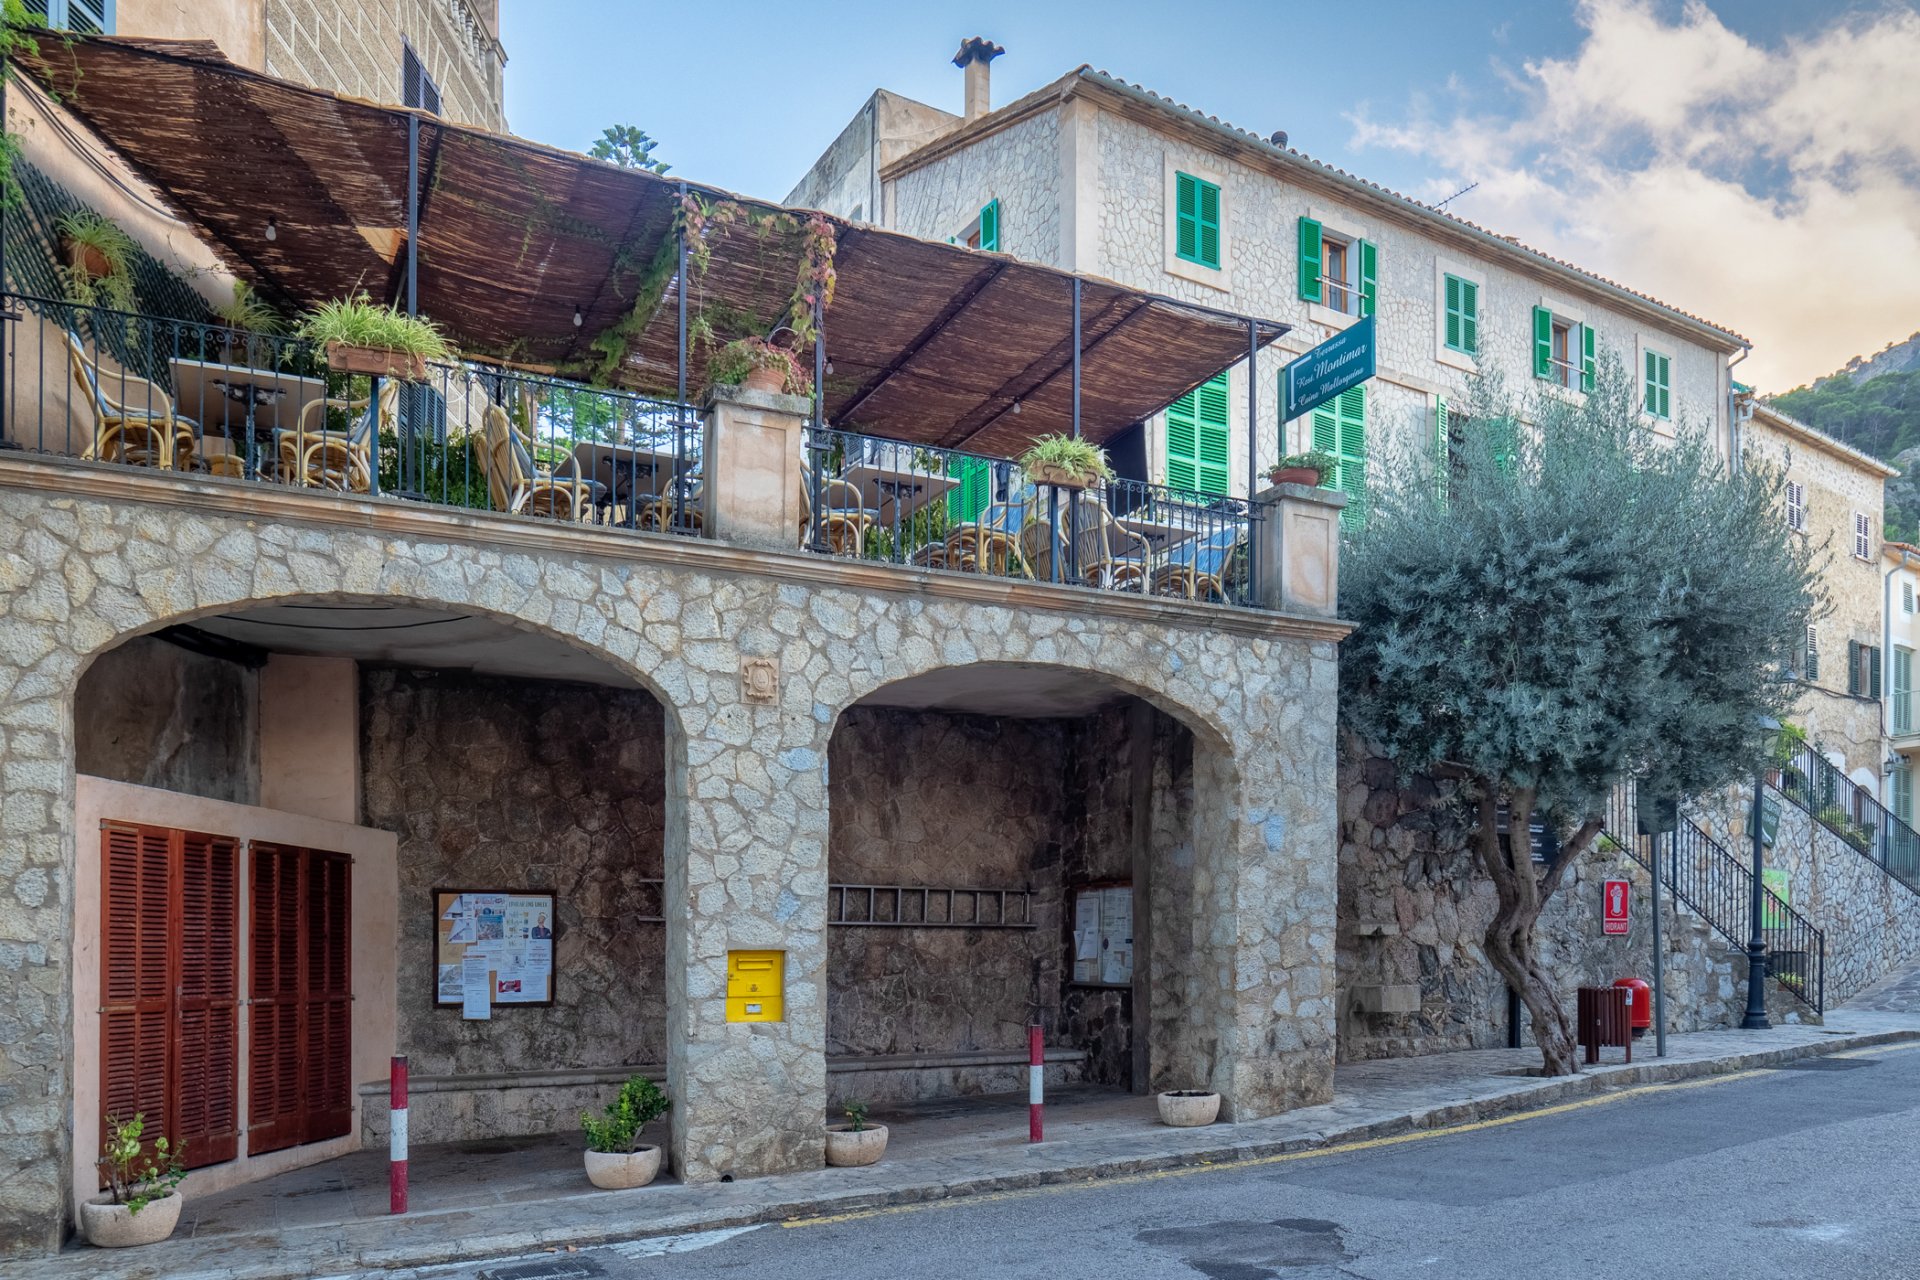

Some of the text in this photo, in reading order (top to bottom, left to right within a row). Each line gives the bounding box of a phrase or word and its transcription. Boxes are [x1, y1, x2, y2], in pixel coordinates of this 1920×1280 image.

[1315, 337, 1347, 358] Terrassa
[1314, 344, 1368, 378] Montimar
[1320, 367, 1364, 395] Mallorquina
[1605, 922, 1627, 931] HIDRANT
